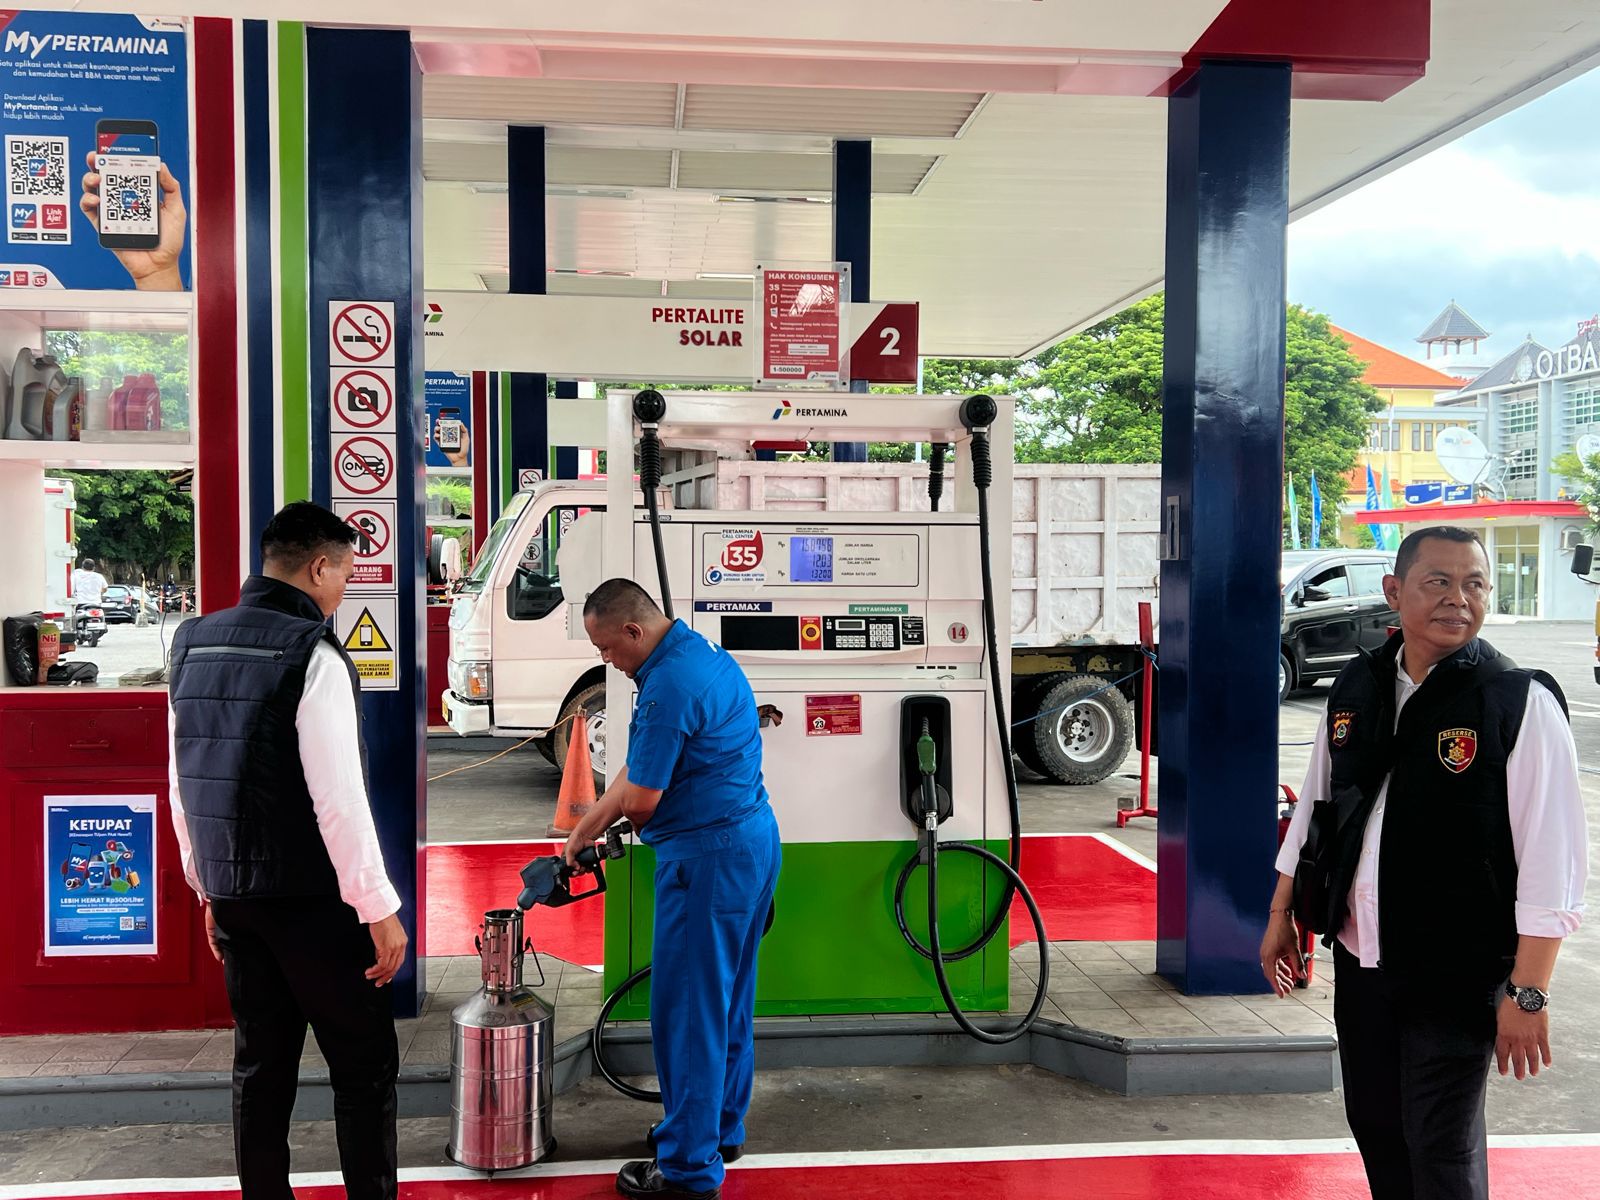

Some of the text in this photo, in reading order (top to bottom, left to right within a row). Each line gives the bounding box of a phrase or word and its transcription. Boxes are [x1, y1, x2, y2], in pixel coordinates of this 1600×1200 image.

[15, 60, 41, 69] aplikasi
[89, 62, 129, 72] keuntungan
[131, 65, 149, 73] point
[150, 65, 176, 73] reward
[13, 69, 26, 77] dan
[28, 69, 68, 78] kemudahan
[4, 93, 64, 102] Download Aplikasi
[4, 102, 58, 112] MyPertamina
[60, 104, 78, 112] untuk
[4, 111, 64, 120] hidup lebih mudah
[14, 208, 34, 220] My
[768, 272, 835, 281] HAK KONSUMEN
[652, 307, 744, 324] PERTALITE
[679, 329, 743, 347] SOLAR
[879, 326, 901, 356] 2
[796, 408, 848, 417] PERTAMINA
[723, 546, 758, 567] 135
[811, 569, 832, 579] 13200
[706, 603, 761, 611] PERTAMAX
[951, 626, 967, 640] 14
[815, 720, 824, 728] 23
[1442, 730, 1473, 738] RESERSE
[69, 819, 132, 831] KETUPAT
